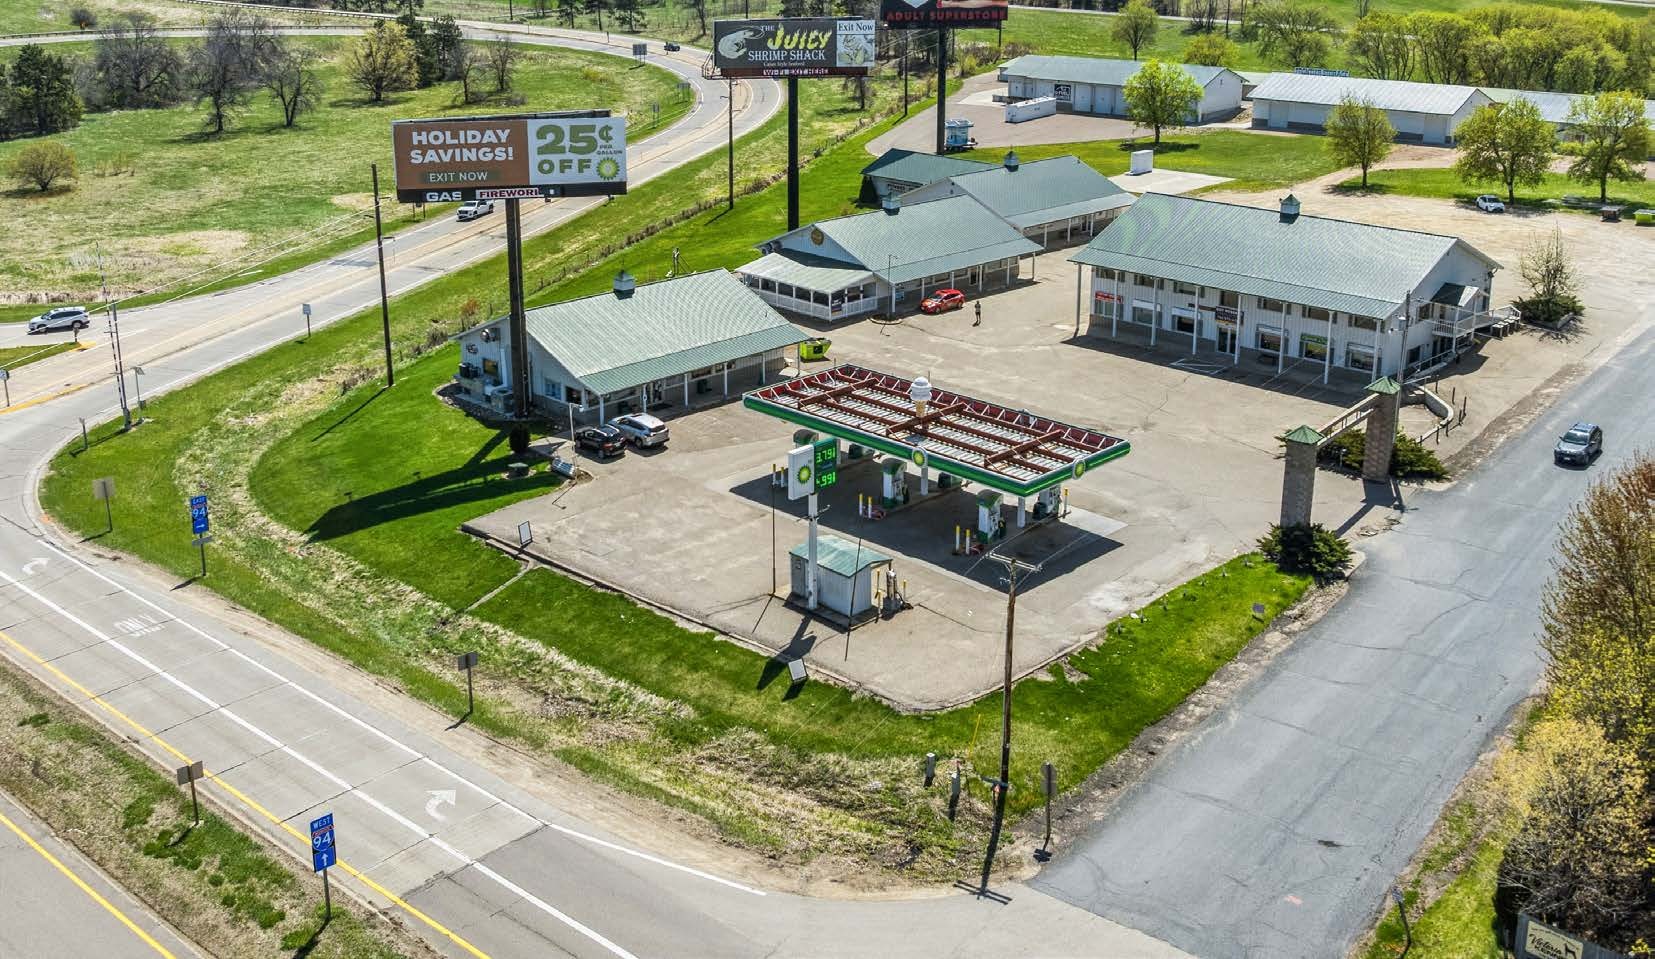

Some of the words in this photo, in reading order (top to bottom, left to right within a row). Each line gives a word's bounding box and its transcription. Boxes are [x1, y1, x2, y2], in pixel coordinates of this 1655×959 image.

[886, 10, 925, 22] ADULT
[929, 9, 1006, 21] SUPERSTORE
[838, 22, 854, 32] Exit
[856, 23, 874, 32] Now
[748, 49, 788, 62] SHRIMP
[789, 49, 825, 61] SHACK
[412, 129, 510, 145] HOLIDAY
[410, 147, 514, 164] SAVINGS!
[537, 157, 593, 175] OFF
[429, 172, 456, 183] EXIT
[459, 171, 488, 182] NOW
[426, 191, 462, 202] GAS
[192, 507, 206, 518] 94
[114, 613, 165, 637] ONLY
[313, 816, 331, 829] WEST
[313, 831, 331, 848] 94
